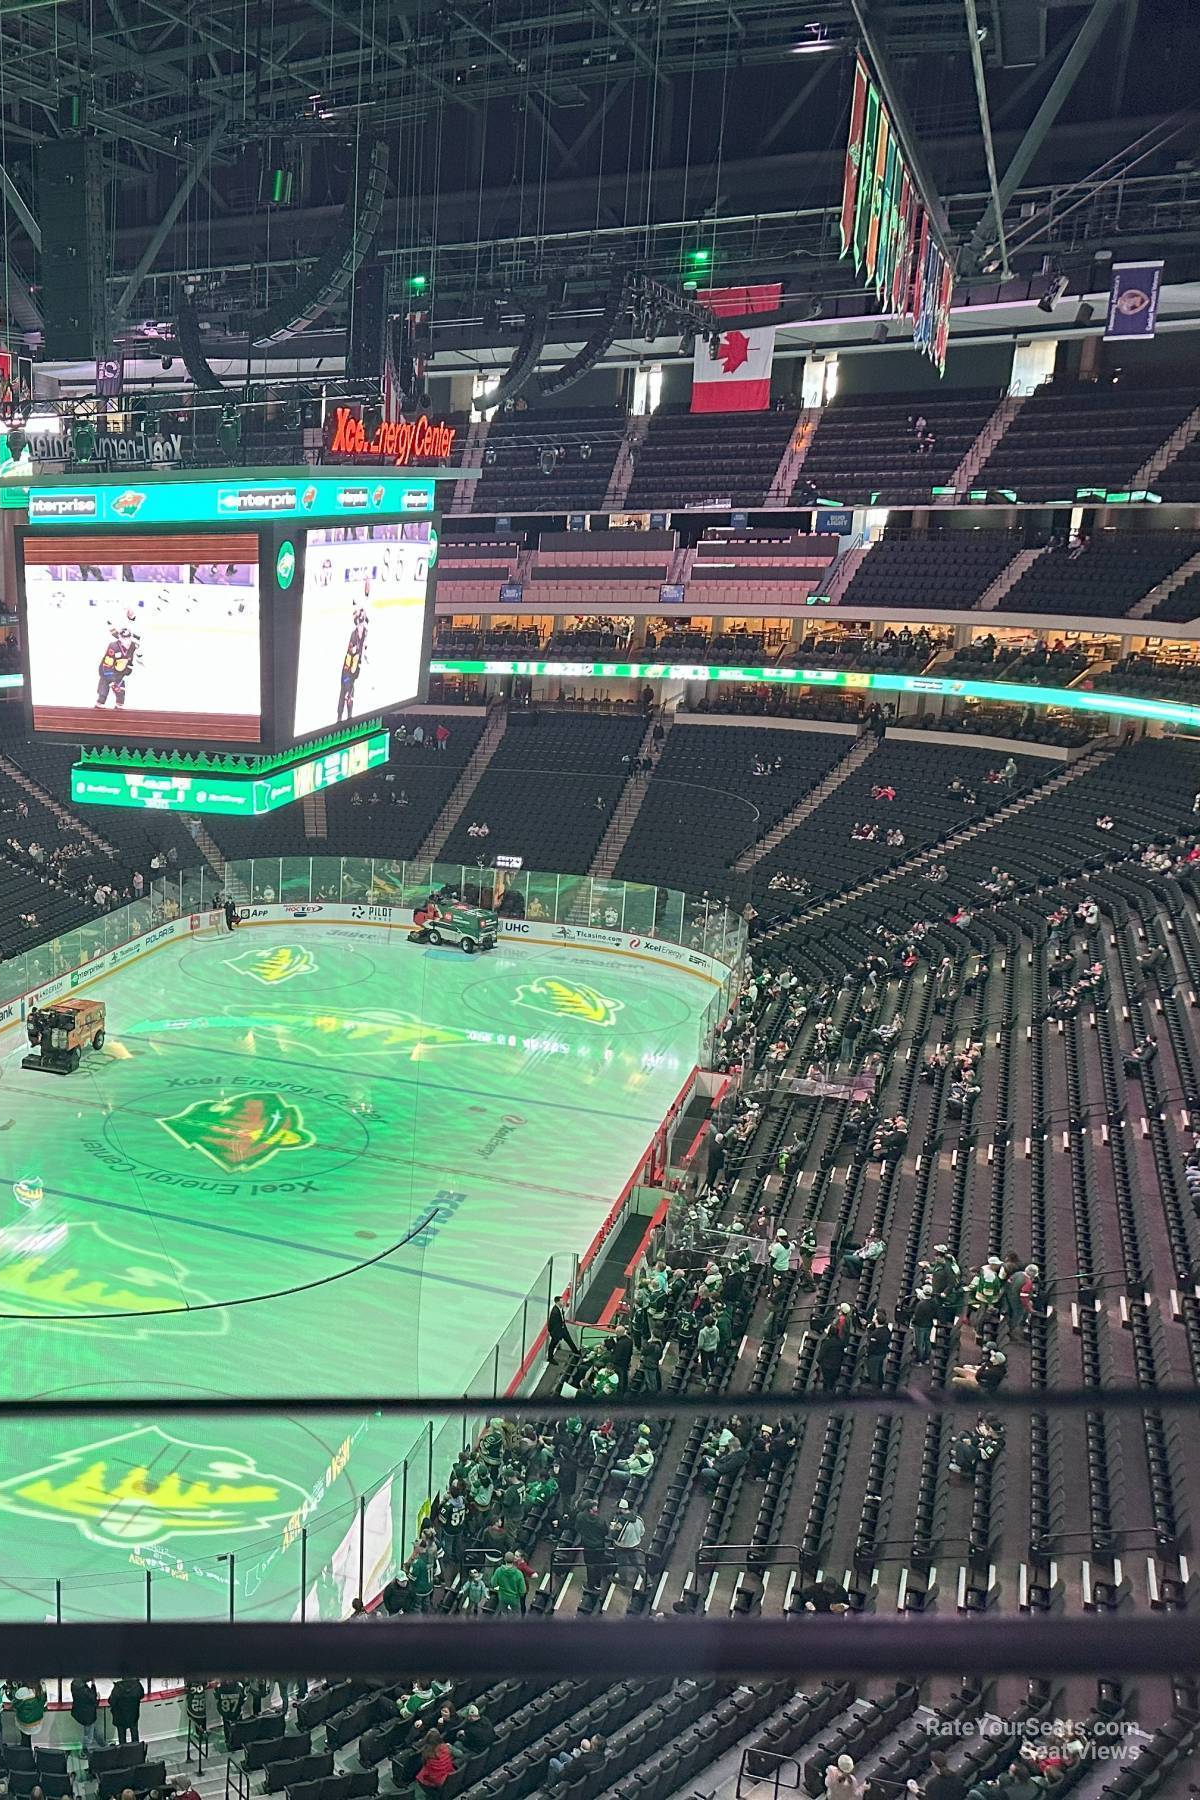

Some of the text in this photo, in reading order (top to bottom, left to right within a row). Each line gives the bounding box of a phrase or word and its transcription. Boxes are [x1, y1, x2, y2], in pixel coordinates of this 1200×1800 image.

[332, 408, 369, 451] Xce
[415, 415, 456, 458] Center
[30, 498, 95, 514] nterprise
[369, 906, 392, 917] PILOT
[145, 926, 175, 946] POLARIS
[505, 923, 530, 933] UHC
[164, 1076, 388, 1125] Xcel Energy Center
[80, 1137, 321, 1196] Xcel Energy Center
[451, 1509, 466, 1526] 97
[221, 1700, 239, 1713] 97
